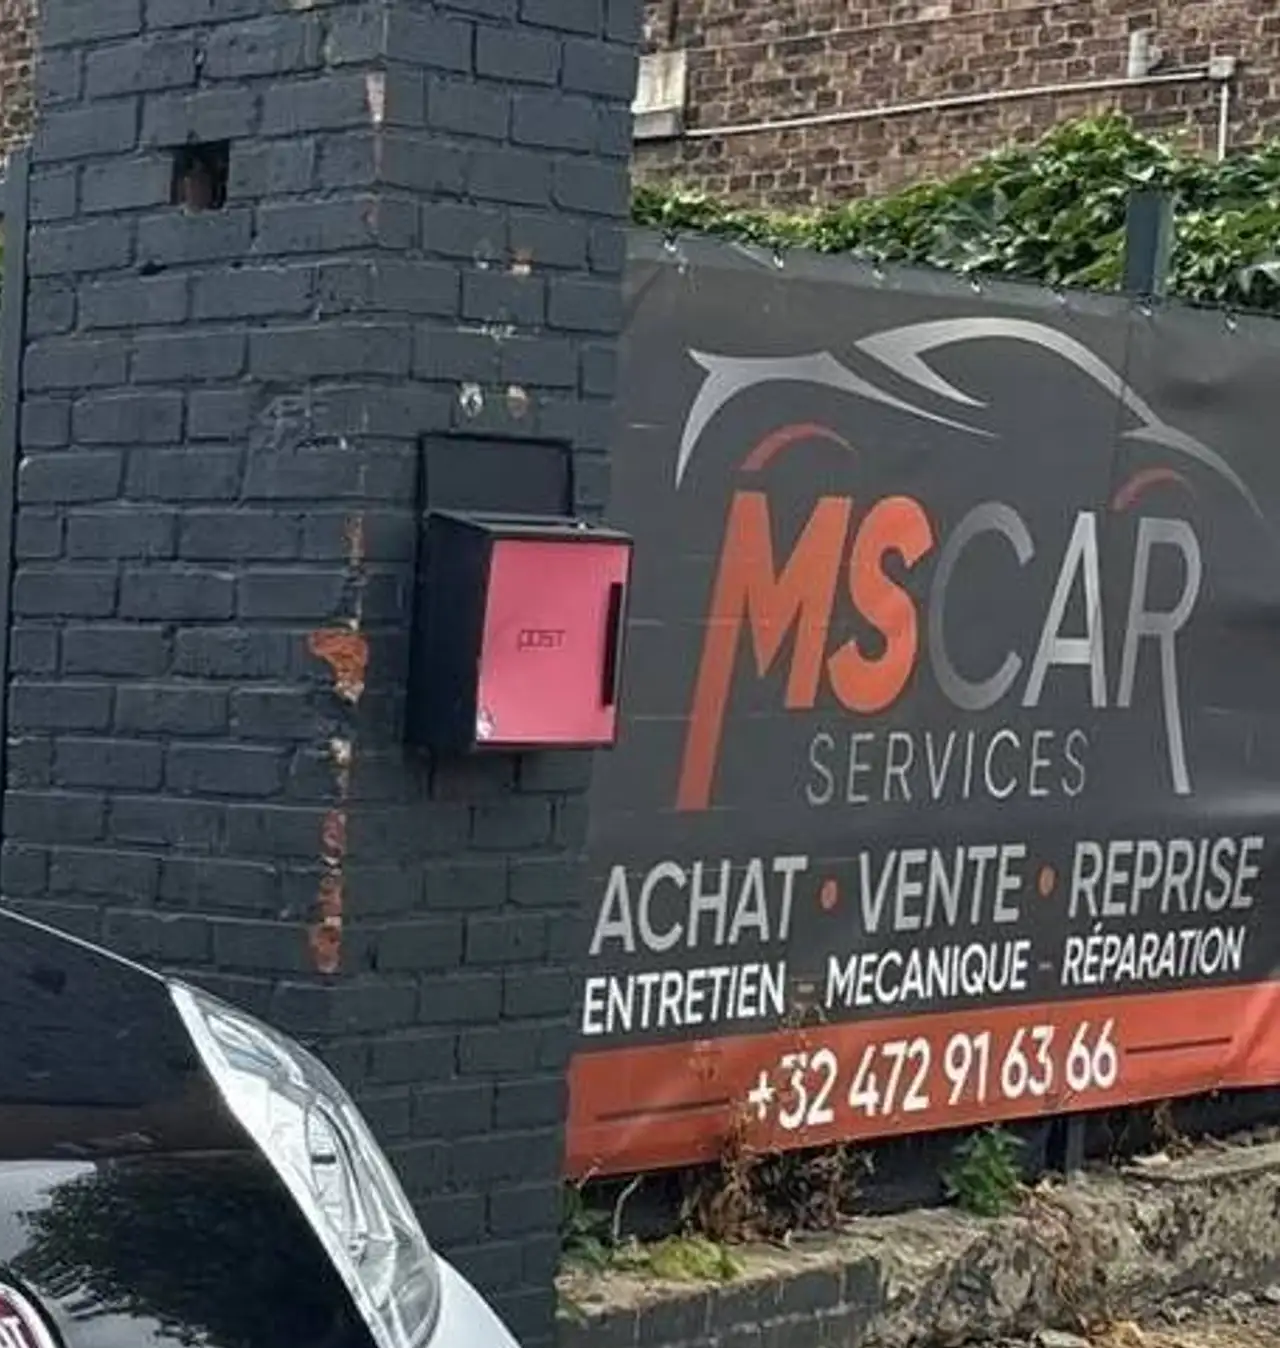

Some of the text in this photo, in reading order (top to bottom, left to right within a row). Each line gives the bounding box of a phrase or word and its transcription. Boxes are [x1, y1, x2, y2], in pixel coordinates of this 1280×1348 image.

[806, 729, 1089, 804] SERVICES
[589, 836, 1265, 955] ACHAT VENTE REPRISE
[582, 923, 1246, 1035] ENTRETIEN MECANIQUE RÉPARATION
[748, 1017, 1119, 1130] +32 472 91 63 66
